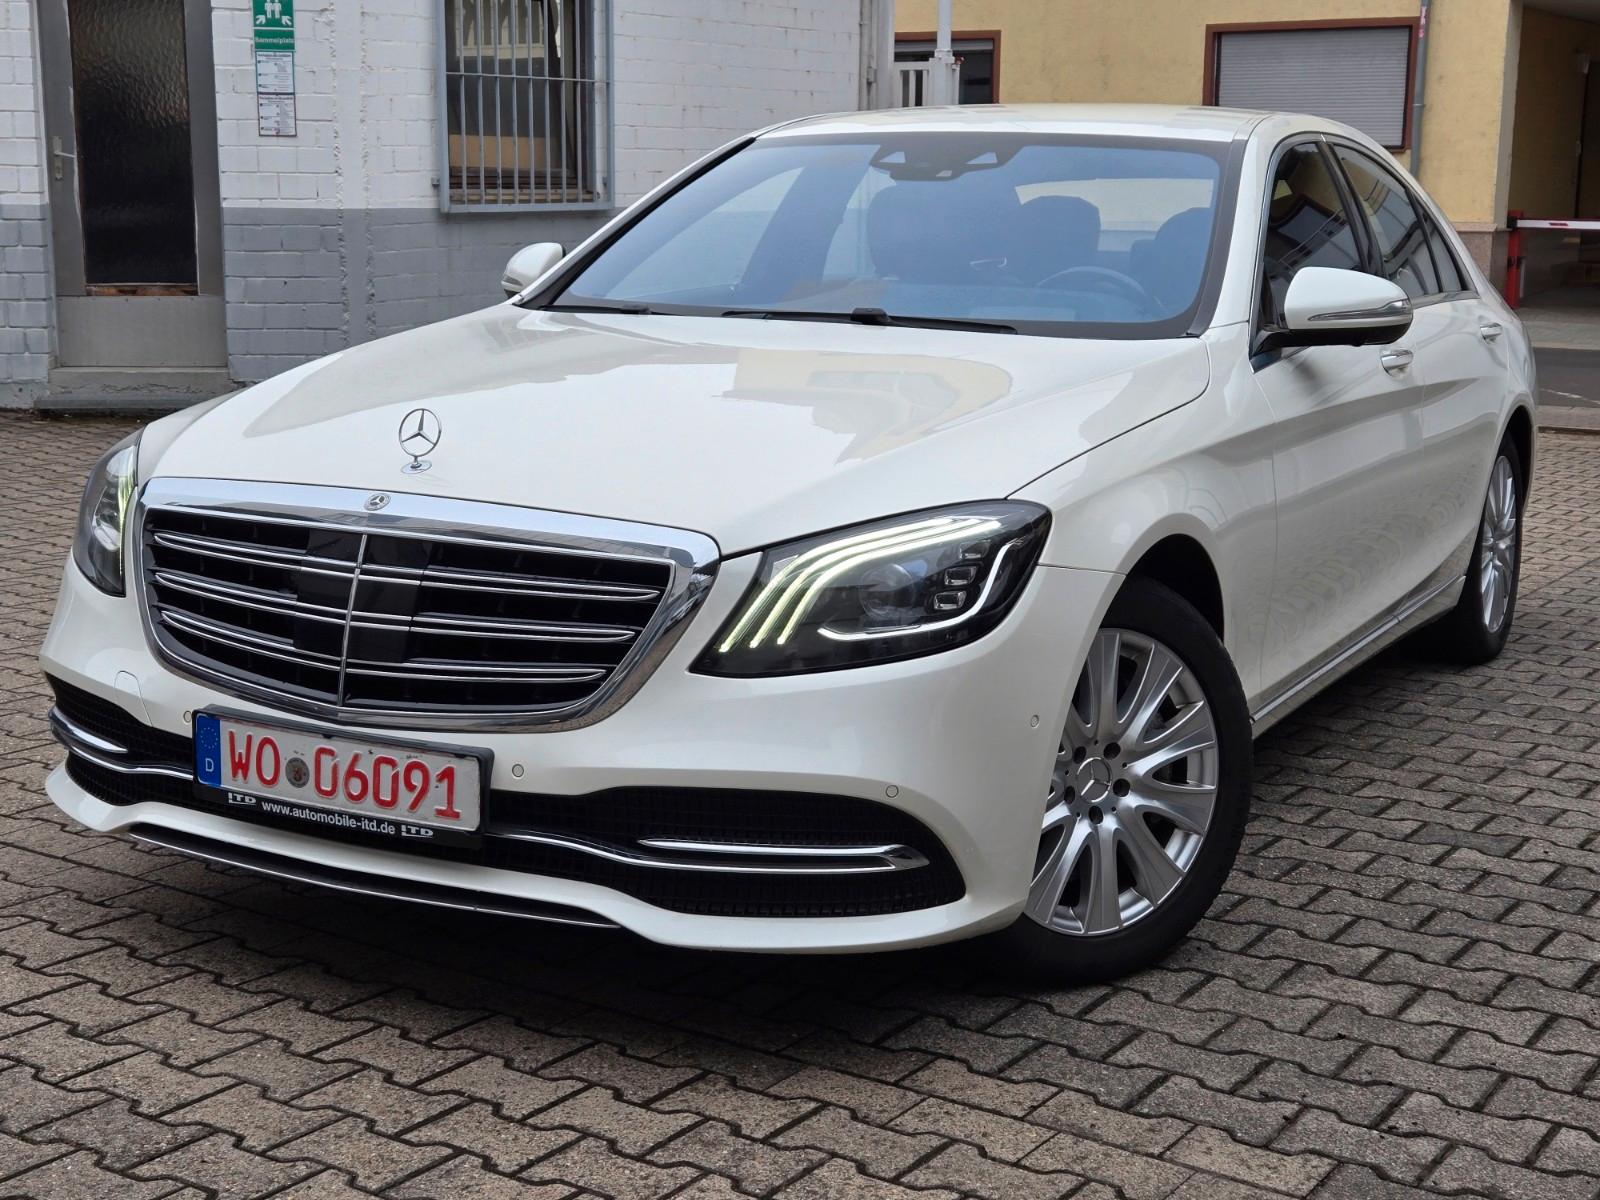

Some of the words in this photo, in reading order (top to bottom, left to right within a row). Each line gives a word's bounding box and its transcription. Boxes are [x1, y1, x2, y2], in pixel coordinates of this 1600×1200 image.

[205, 758, 215, 773] D
[228, 730, 281, 786] WO
[314, 746, 461, 820] 06091
[261, 801, 396, 835] www.automobile-itd.de
